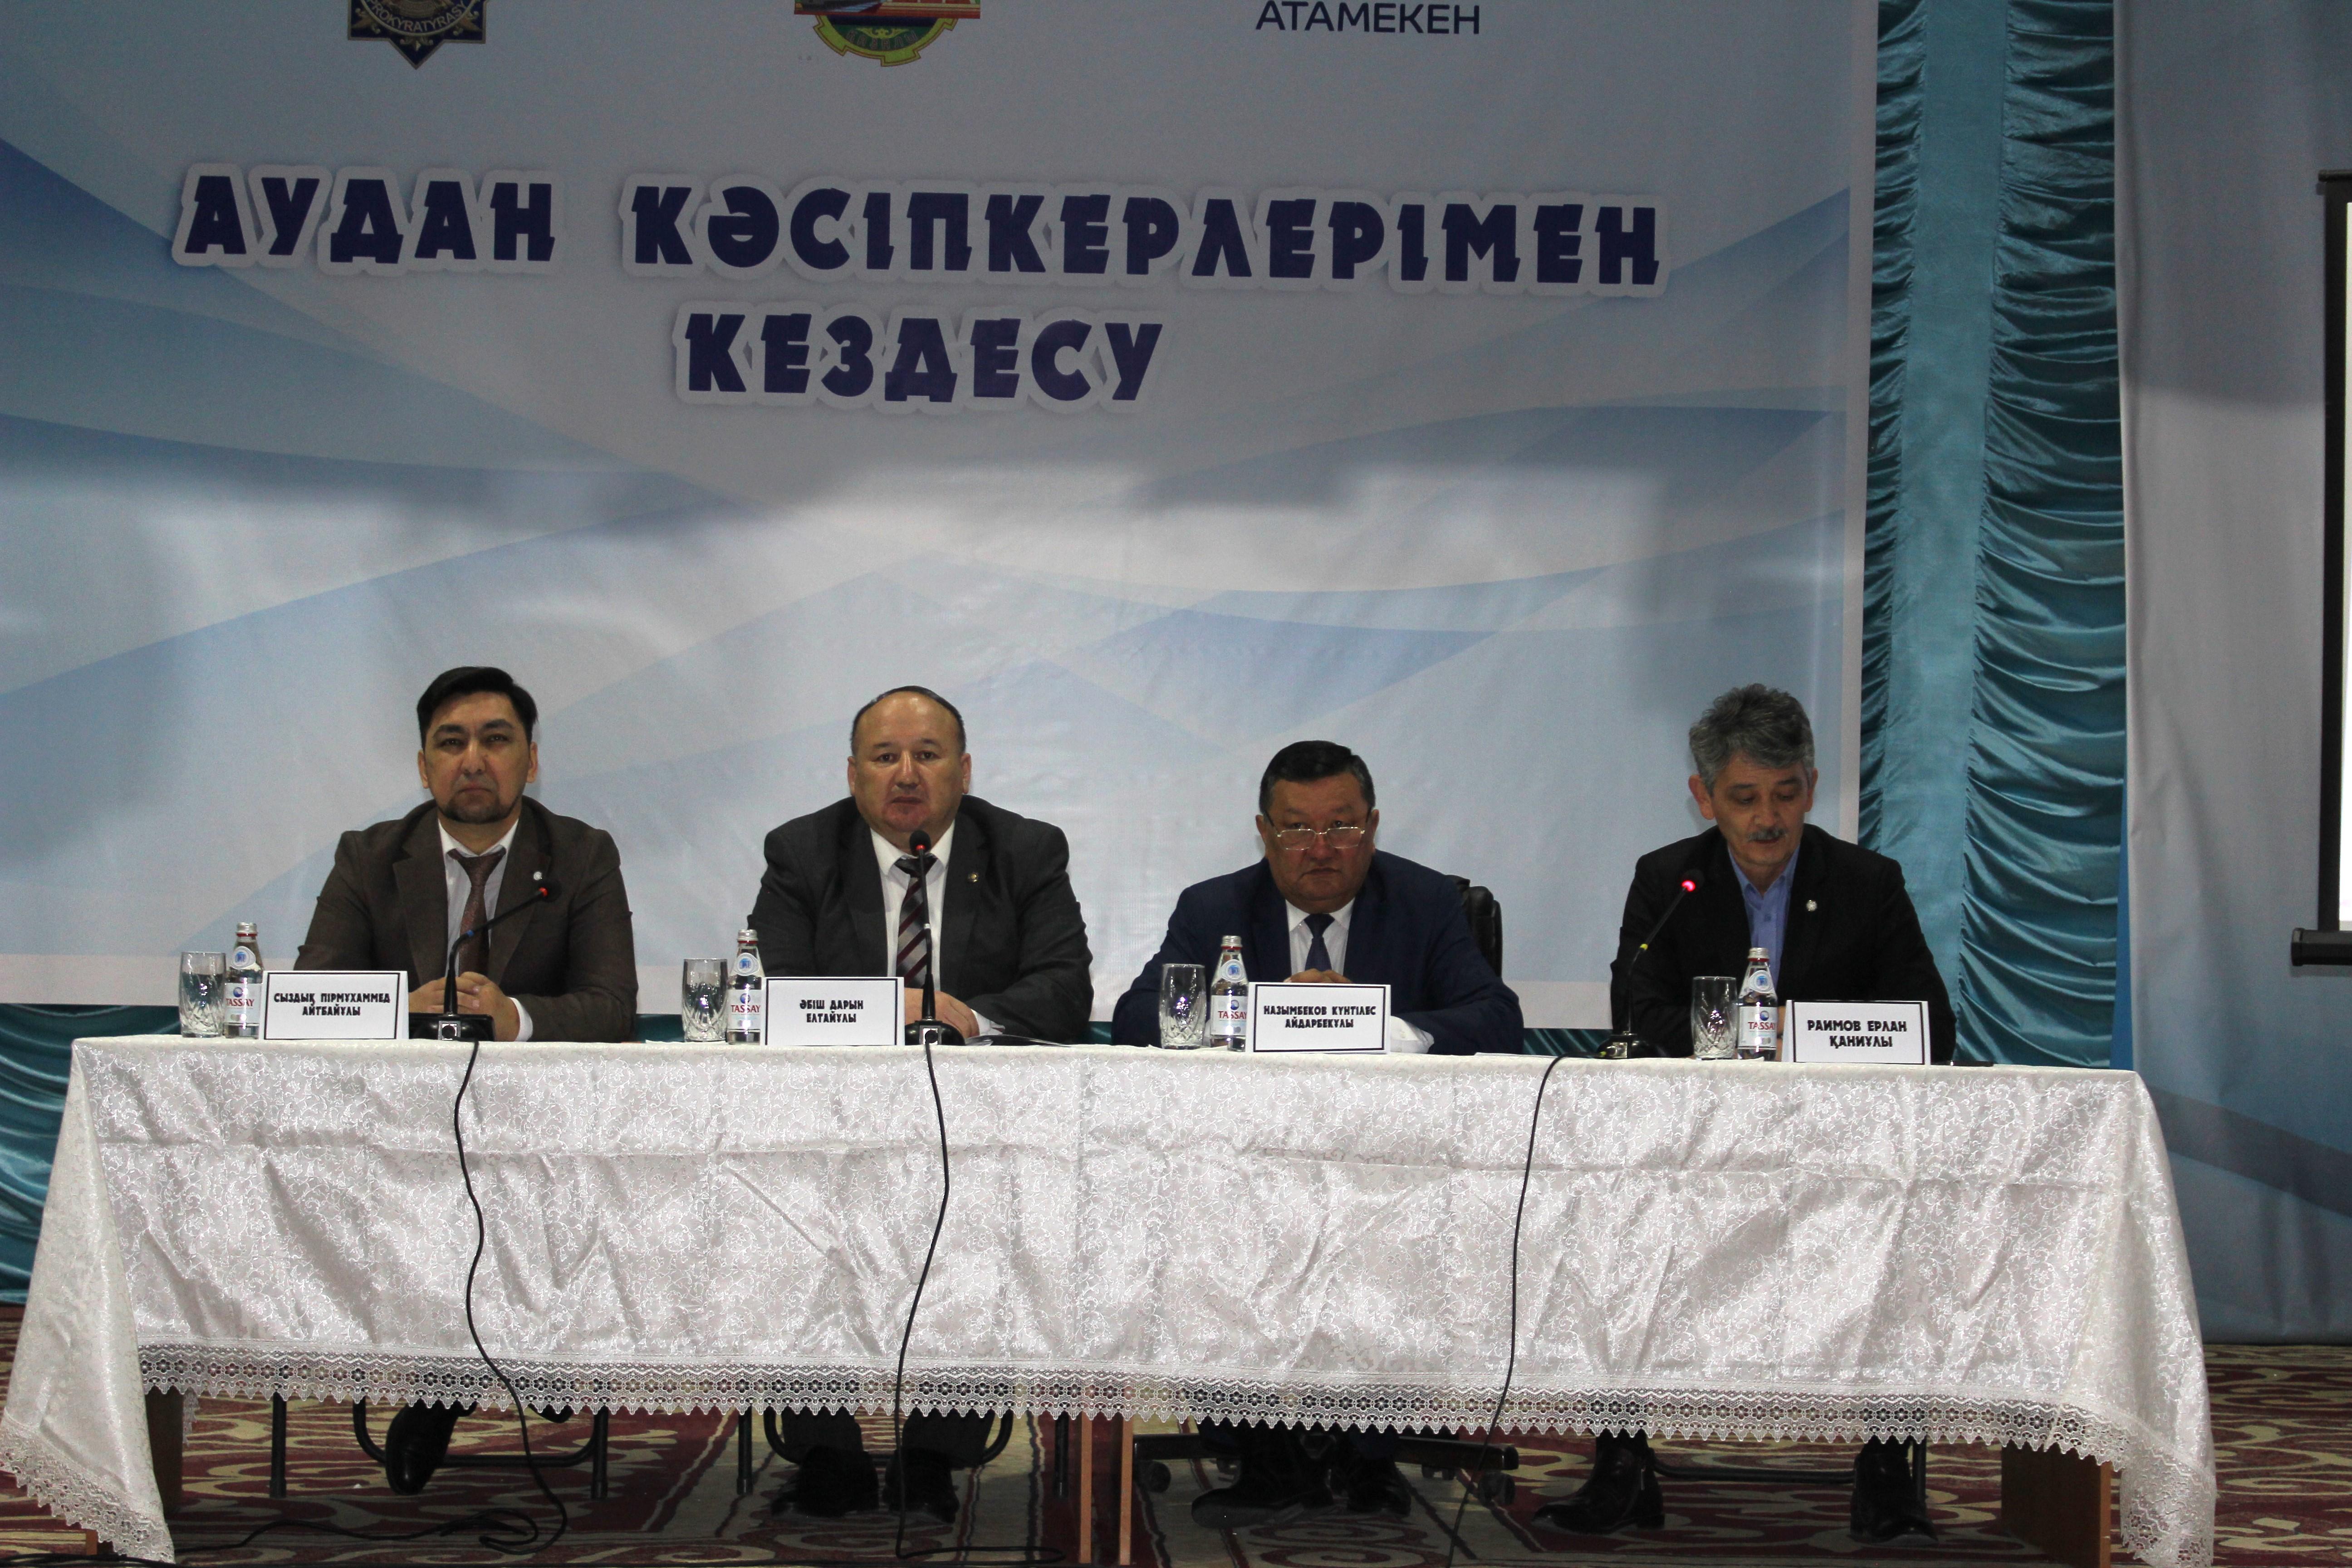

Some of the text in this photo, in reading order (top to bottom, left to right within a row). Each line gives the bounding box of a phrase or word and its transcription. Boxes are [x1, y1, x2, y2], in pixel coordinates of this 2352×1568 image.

[1255, 0, 1480, 34] АТАМЕКЕН
[184, 176, 1659, 285] АУДАН КӘСІПКЕРЛЕРІМЕН
[685, 313, 1163, 403] КЕЗДЕСУ
[274, 993, 316, 1004] СЫЗДЫҚ
[800, 1000, 863, 1010] ӘБІШ ДАРЫН
[1264, 1005, 1327, 1015] НАЗЫМБЕКОВ
[1808, 1020, 1907, 1032] РАИМОВ ЕРЛАН
